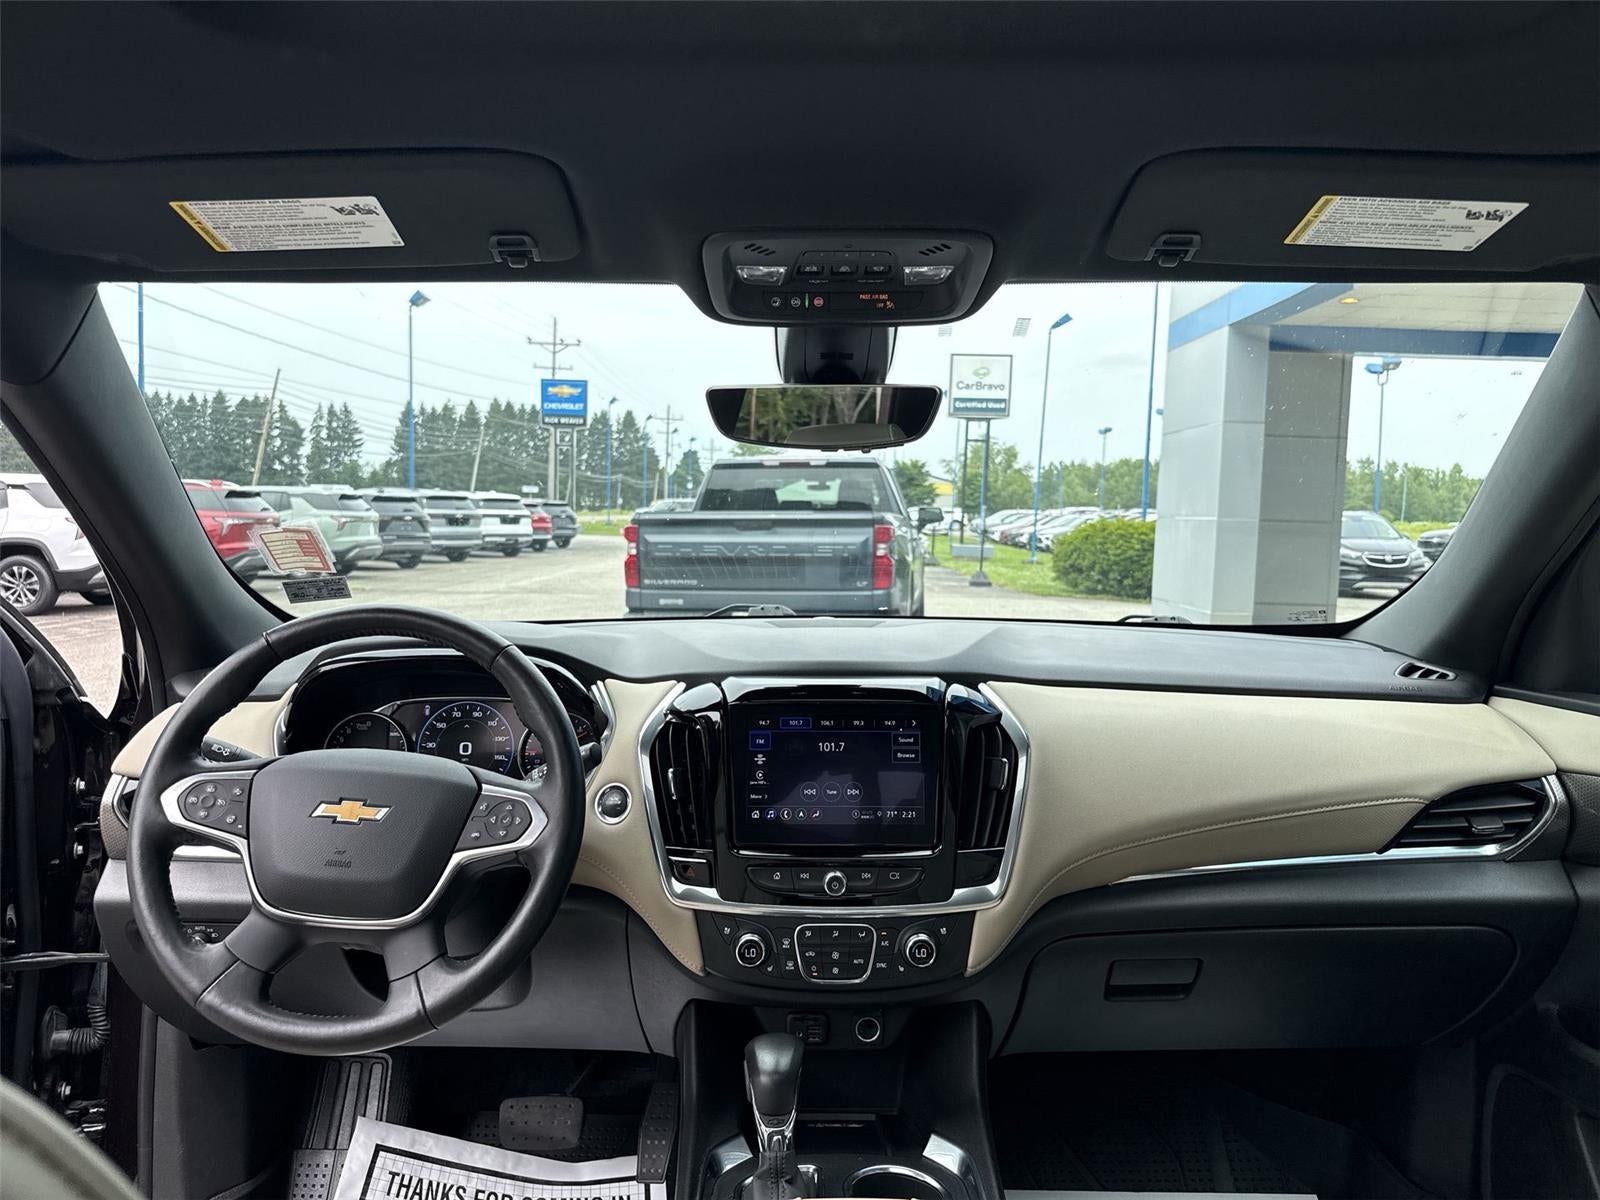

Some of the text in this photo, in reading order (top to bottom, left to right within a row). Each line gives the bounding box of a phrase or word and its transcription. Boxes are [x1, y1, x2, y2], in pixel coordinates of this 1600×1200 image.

[956, 380, 1005, 391] CarBravo
[543, 402, 585, 411] CHEVROLET
[954, 400, 1006, 409] Certified Used
[643, 578, 698, 586] SILVERADO
[458, 741, 473, 756] 0
[818, 742, 845, 752] 101.7
[386, 1170, 467, 1200] THANKS
